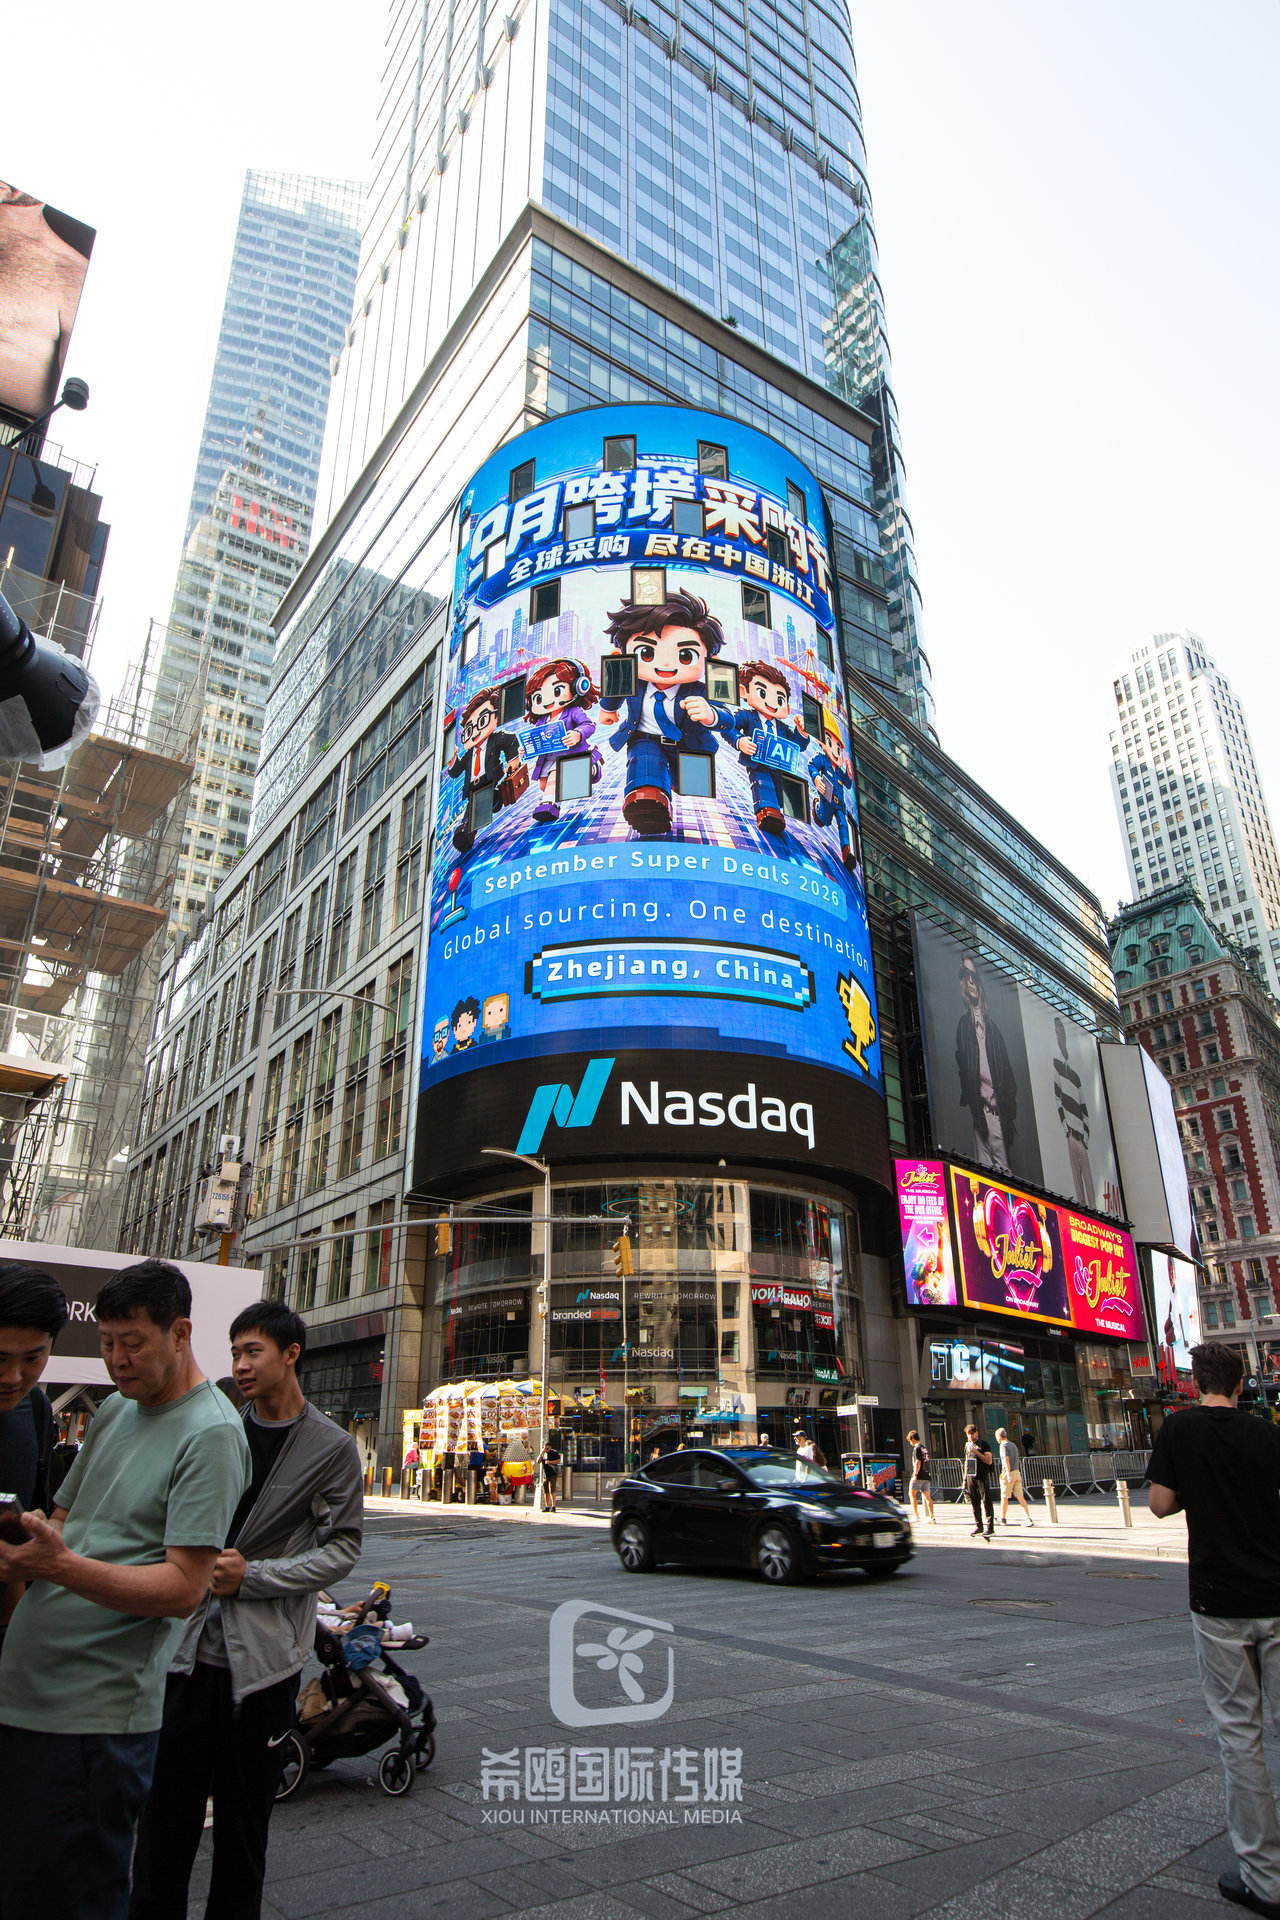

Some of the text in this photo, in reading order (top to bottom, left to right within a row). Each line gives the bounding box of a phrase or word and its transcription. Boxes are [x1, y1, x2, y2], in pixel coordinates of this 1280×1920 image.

[507, 534, 815, 609] 全球采购 尽在中国浙江
[771, 742, 792, 763] AI
[484, 850, 839, 906] September Super Deals 2026
[443, 898, 869, 974] Global sourcing. One destination
[547, 954, 794, 989] Zhejiang, China
[621, 1081, 815, 1149] Nasdaq
[901, 1171, 941, 1187] Juliet
[1069, 1216, 1122, 1243] BROADWAY'S
[1071, 1228, 1125, 1258] BIGGEST POP HIT
[991, 1234, 1041, 1278] Juliet
[1074, 1256, 1131, 1308] & Juliet
[490, 1299, 522, 1308] TOMORROW
[590, 1291, 717, 1301] Nasdaq REWRITE TOMORROW
[1014, 1297, 1039, 1308] BROADWAY
[66, 1301, 97, 1322] RK
[1095, 1318, 1126, 1332] THE MUSICAL
[632, 1347, 674, 1359] Nasdaq
